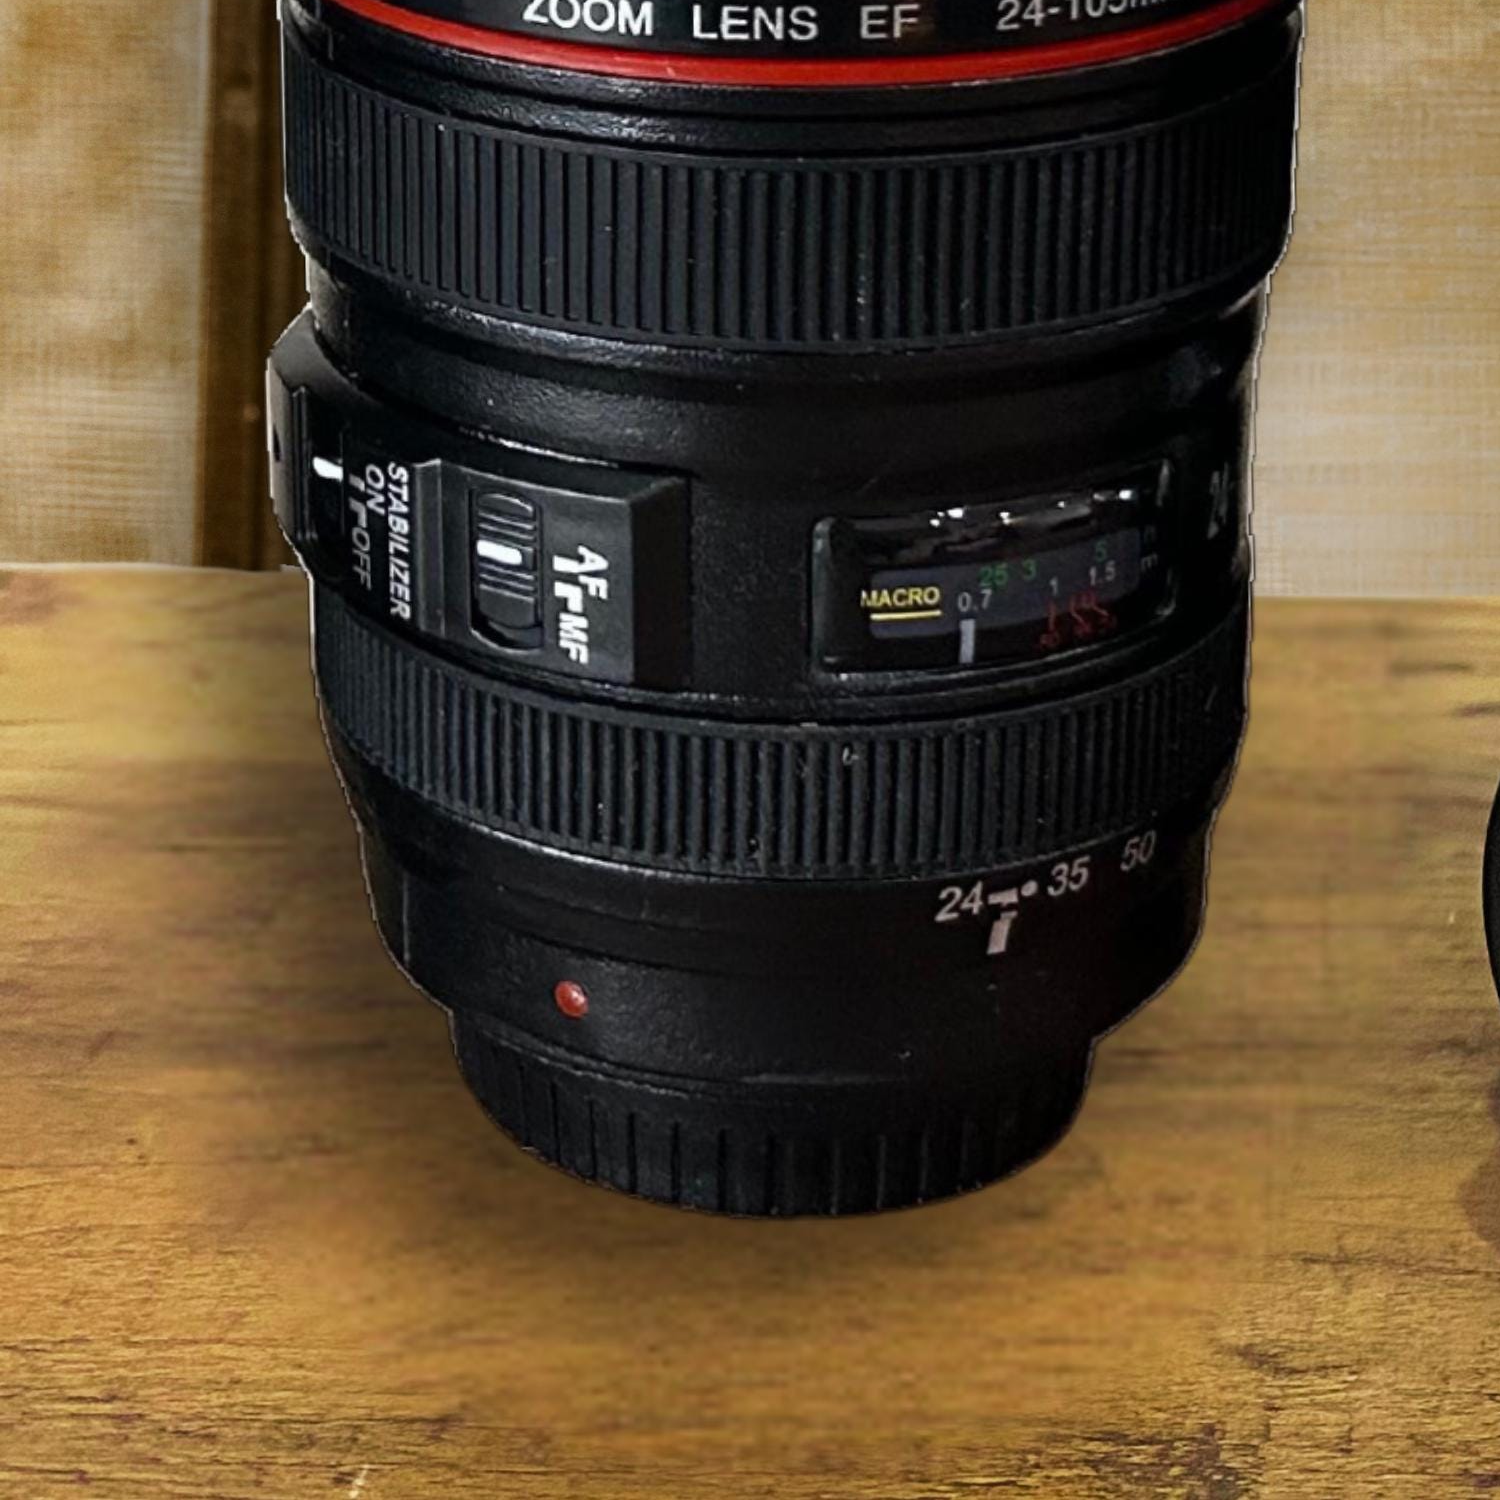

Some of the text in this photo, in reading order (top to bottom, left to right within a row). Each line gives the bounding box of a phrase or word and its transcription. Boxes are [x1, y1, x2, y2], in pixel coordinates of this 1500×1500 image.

[692, 5, 818, 41] LENS
[858, 4, 920, 41] EF
[365, 464, 386, 517] ON
[351, 526, 372, 591] OFF
[387, 461, 411, 621] STABILIZER
[577, 545, 609, 600] AF
[860, 586, 941, 609] MACRO
[957, 588, 992, 613] 0.7
[557, 613, 590, 665] MF
[934, 829, 1157, 923] 24 35 50
